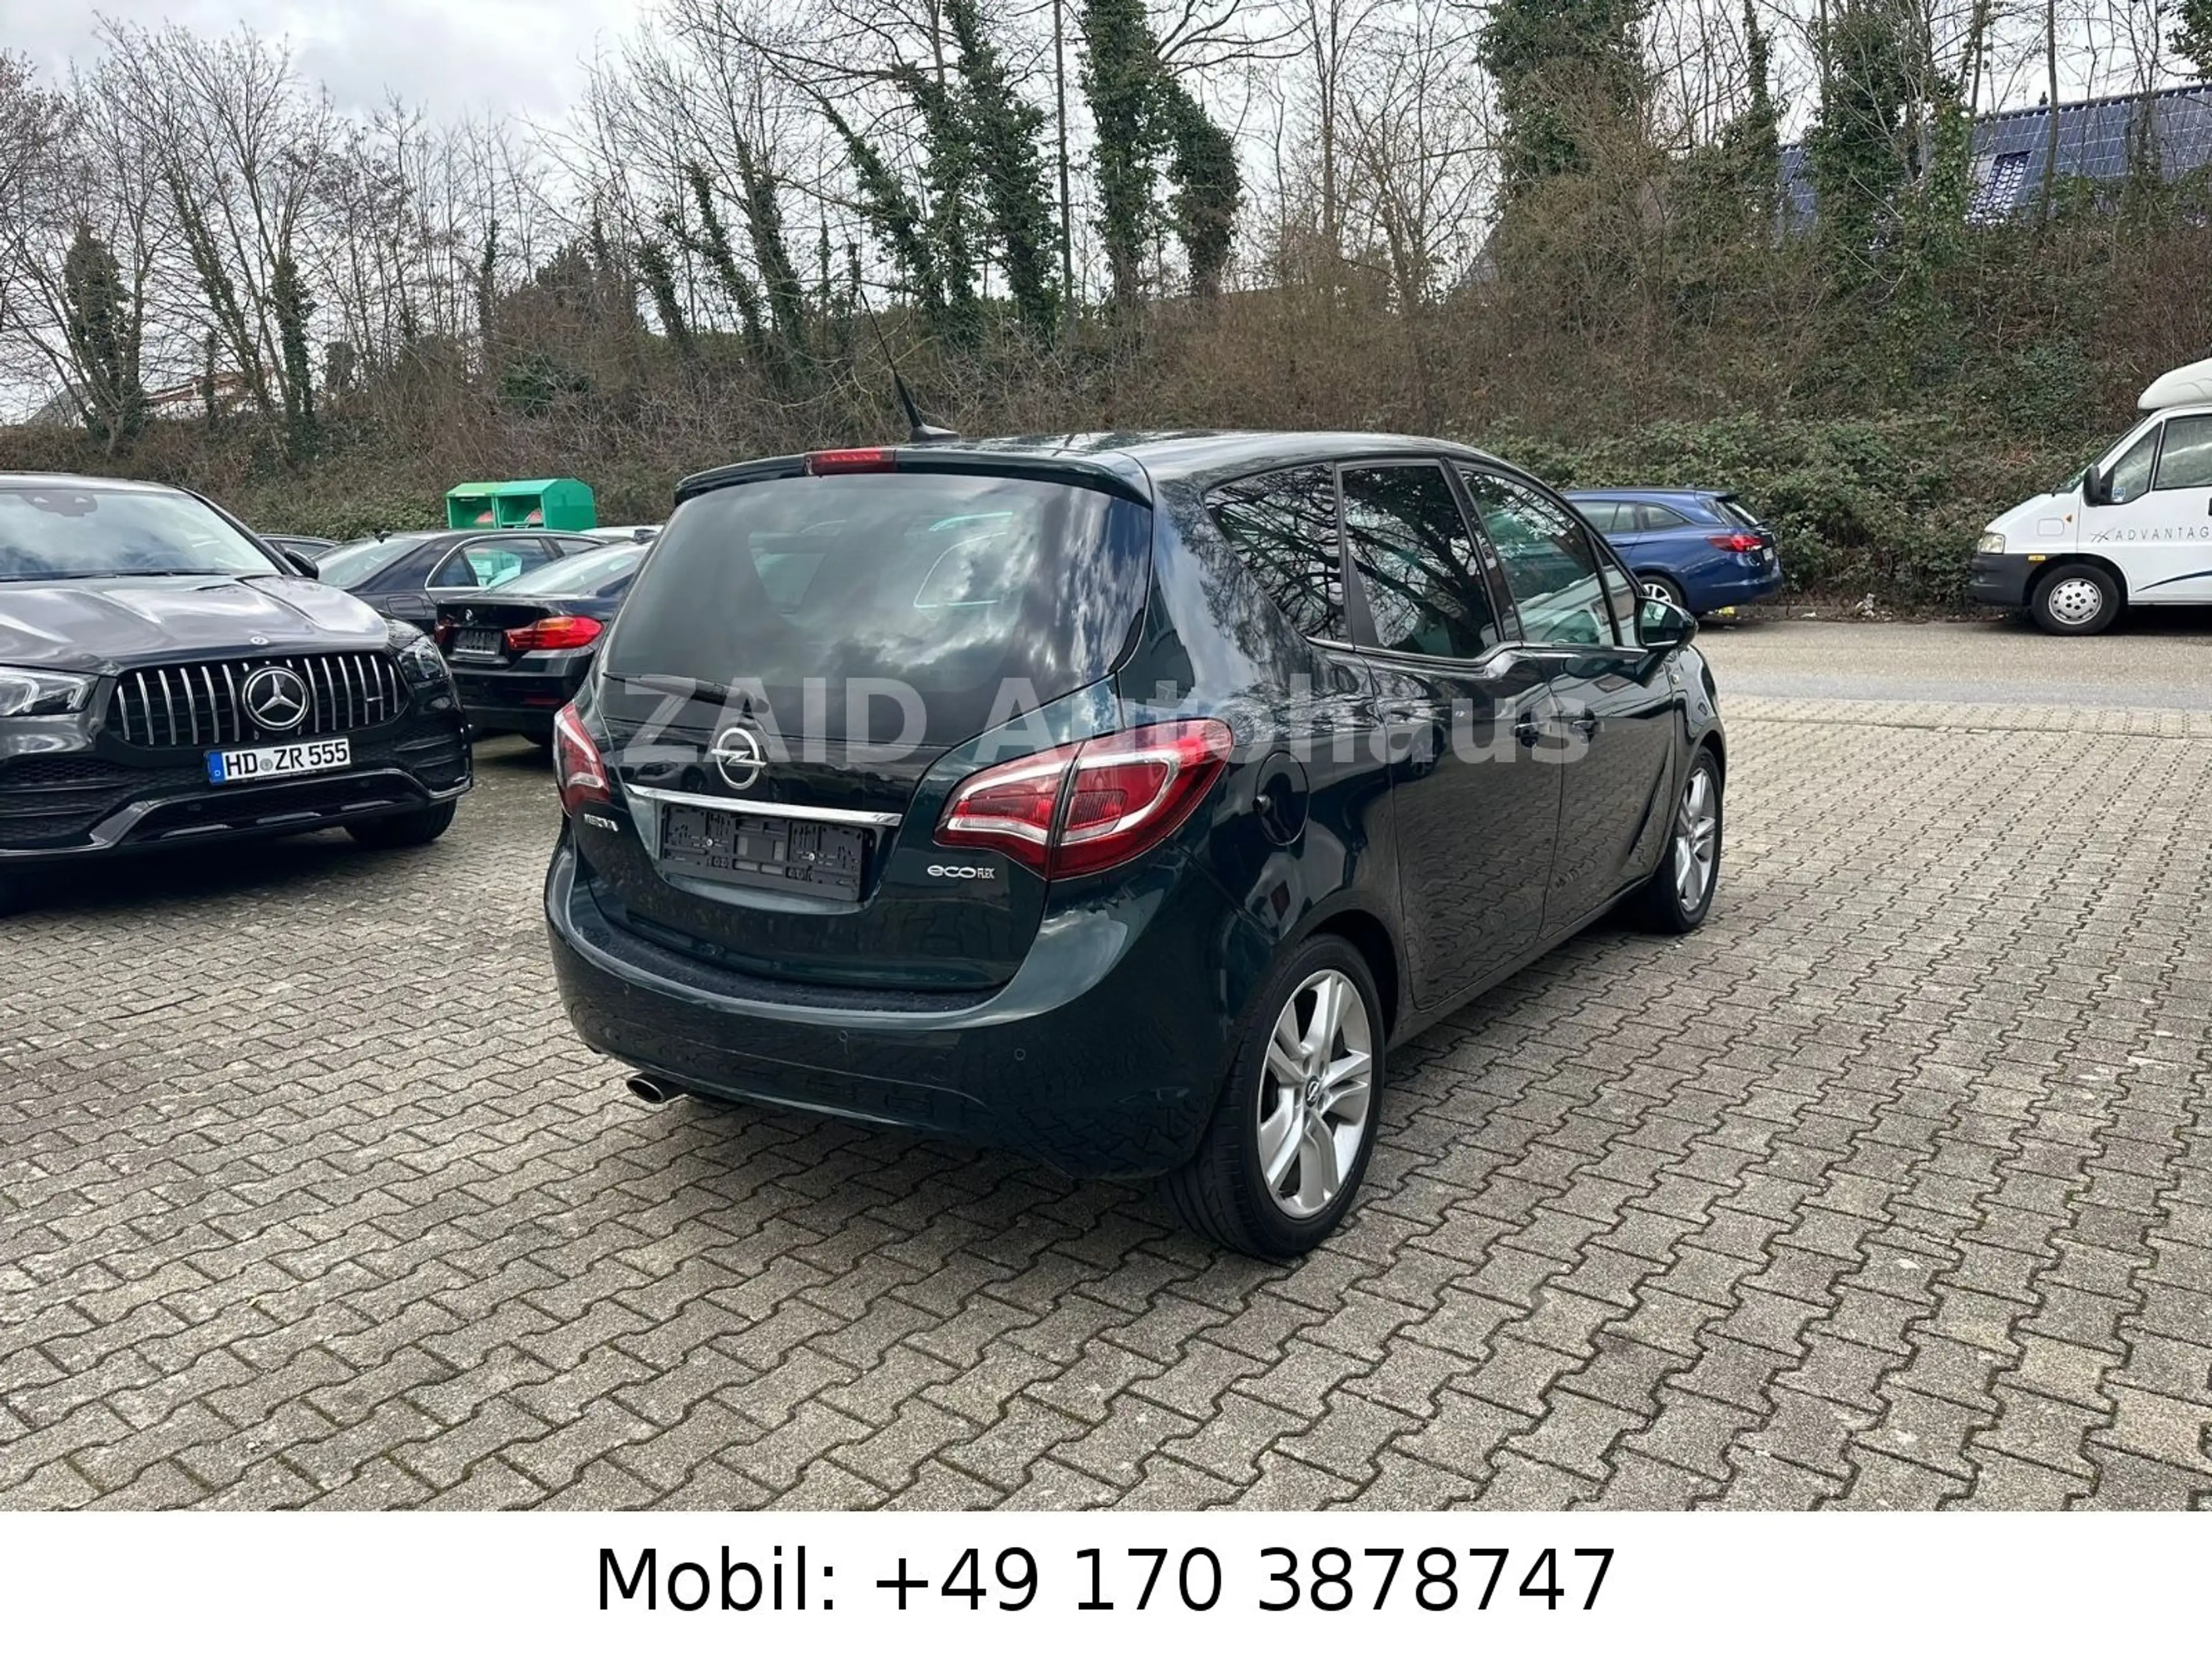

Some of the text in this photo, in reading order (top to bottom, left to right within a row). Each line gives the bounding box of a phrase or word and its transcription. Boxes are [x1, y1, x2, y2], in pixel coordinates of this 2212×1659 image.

[225, 752, 258, 776] HD
[273, 748, 304, 771] ZR
[308, 741, 347, 766] 555
